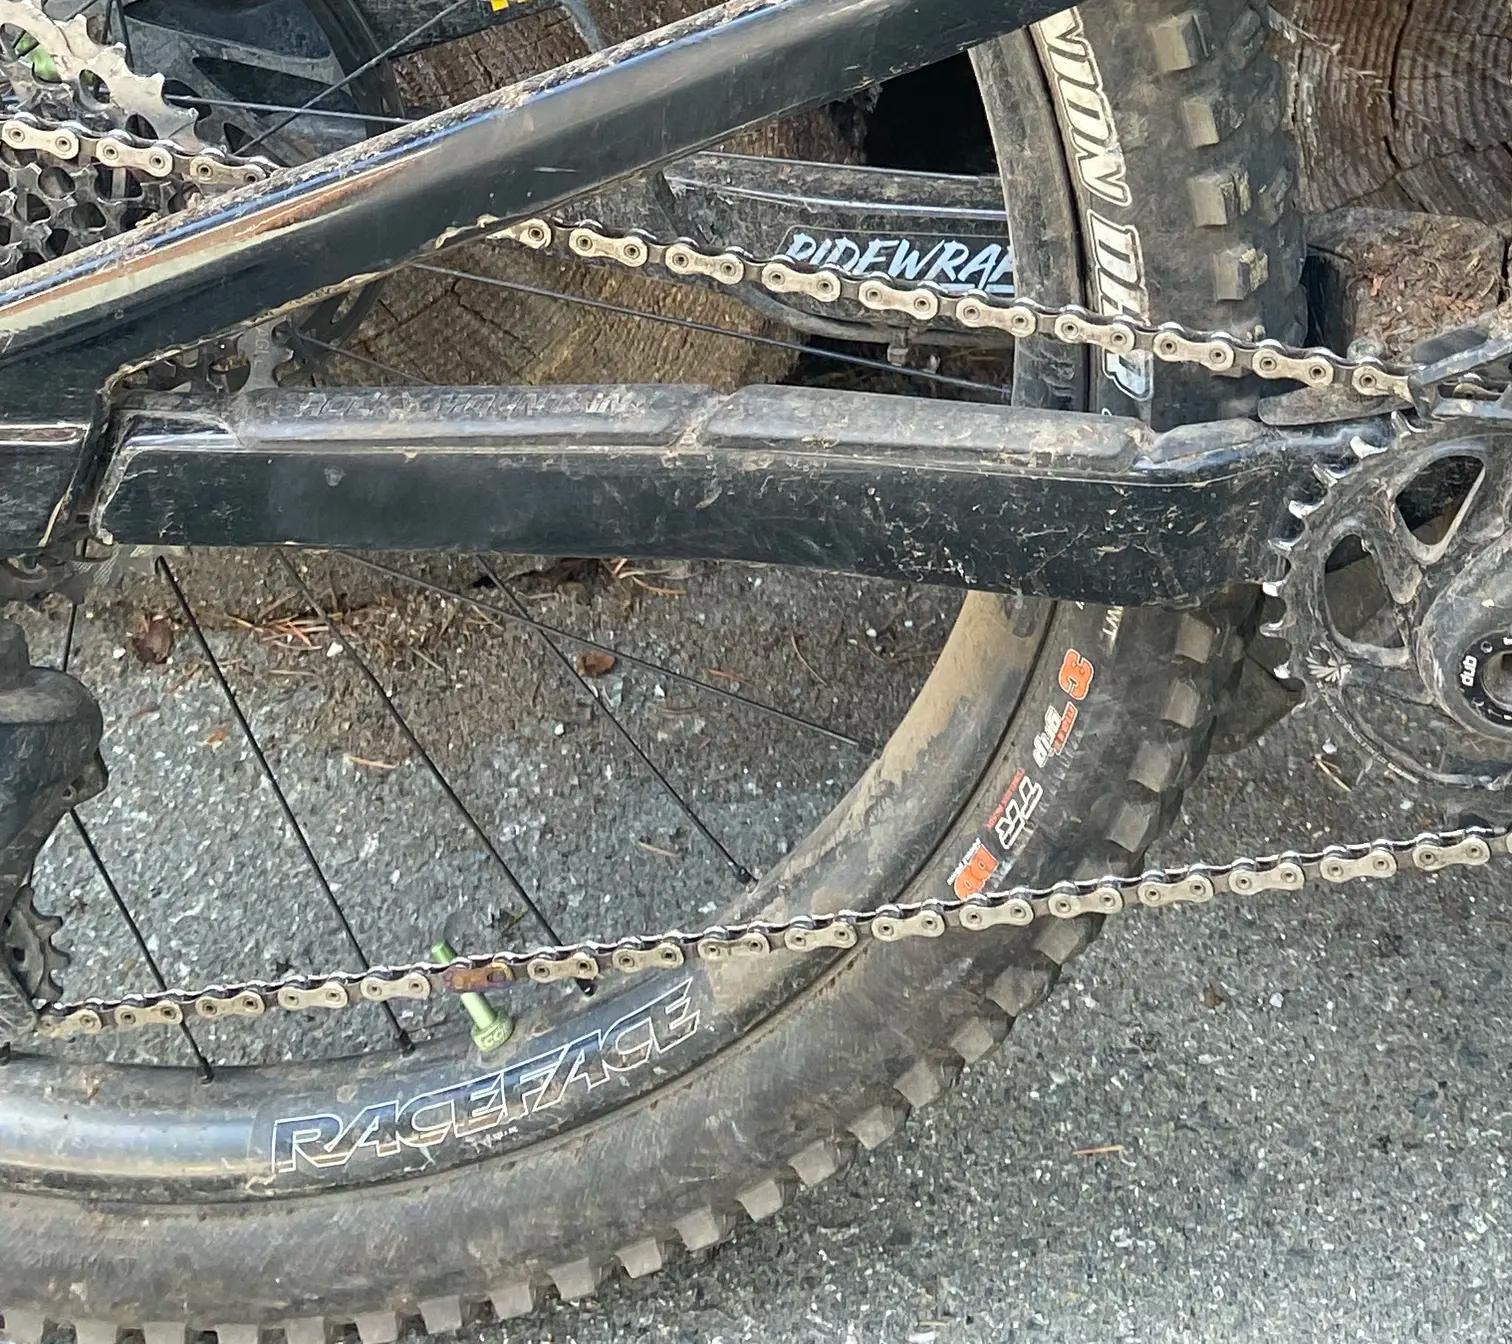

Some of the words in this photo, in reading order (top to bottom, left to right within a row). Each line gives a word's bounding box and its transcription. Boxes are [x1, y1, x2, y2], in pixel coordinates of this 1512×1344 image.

[1036, 6, 1132, 207] NION
[1058, 648, 1095, 701] 3C
[1459, 653, 1478, 688] dub
[995, 775, 1043, 850] TR
[271, 976, 701, 1174] RACEFACE
